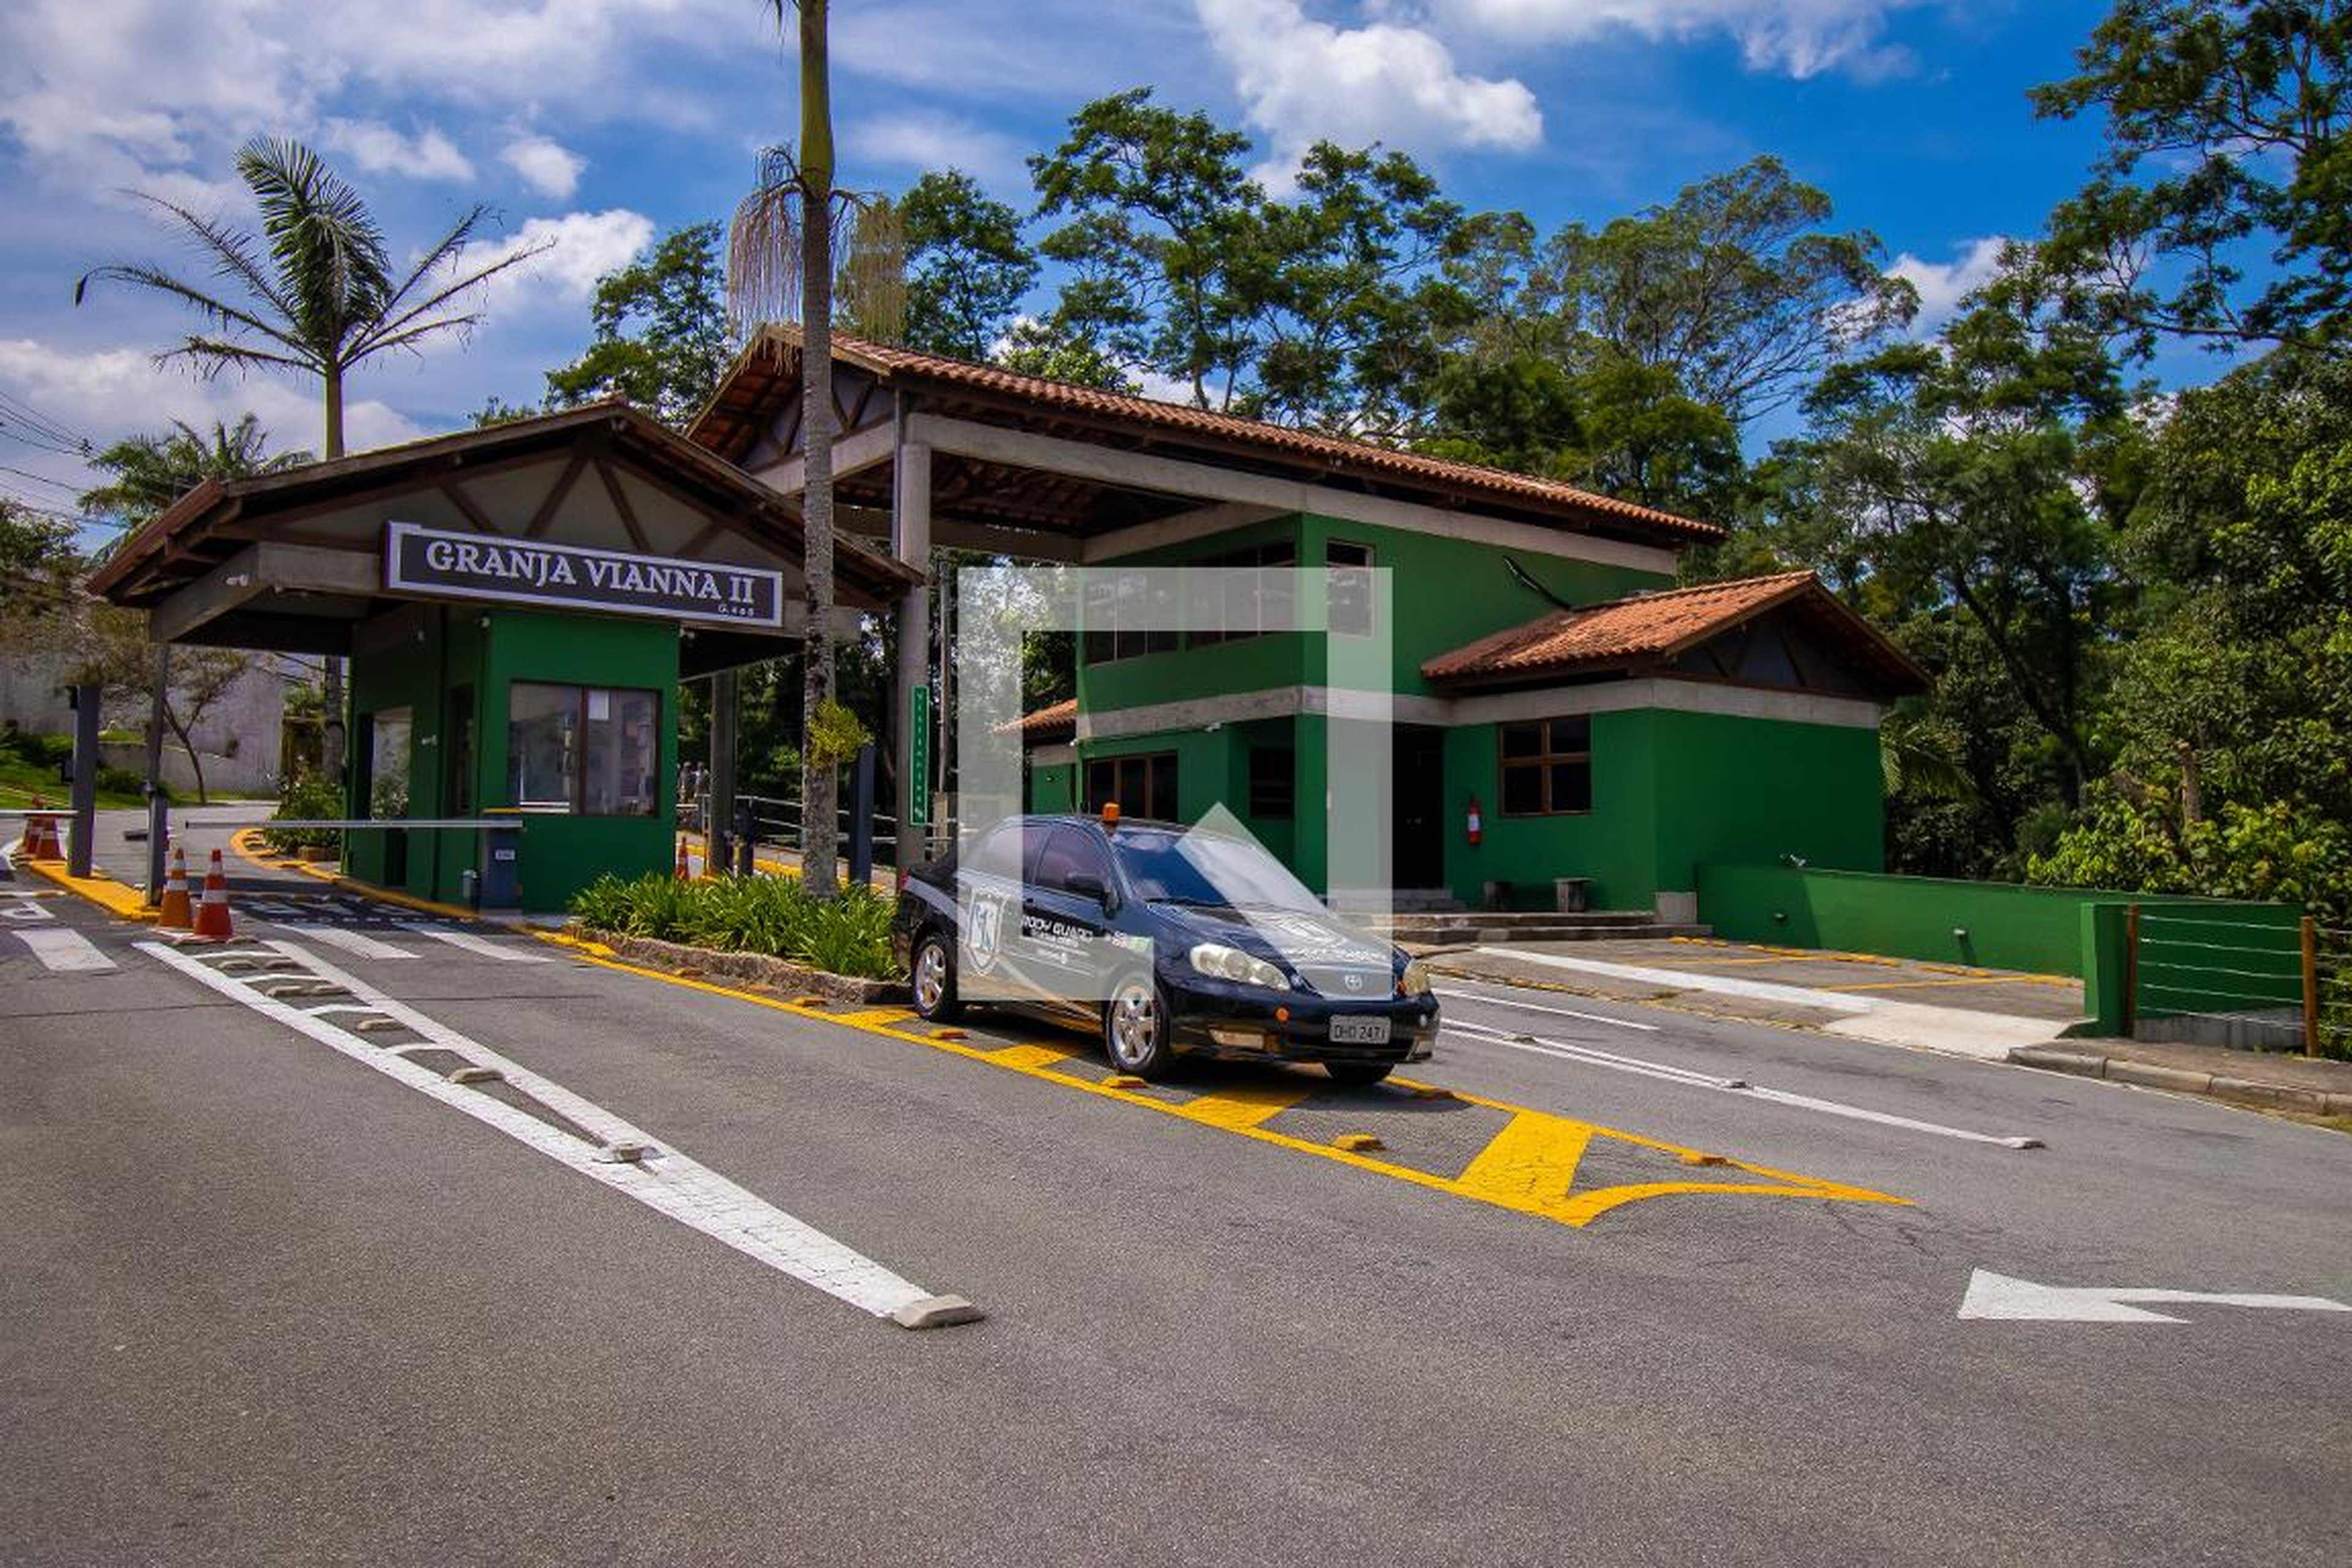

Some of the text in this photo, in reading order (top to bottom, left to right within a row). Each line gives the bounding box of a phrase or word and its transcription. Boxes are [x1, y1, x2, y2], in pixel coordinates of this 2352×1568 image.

[425, 540, 755, 604] GRANJA VIANNA II
